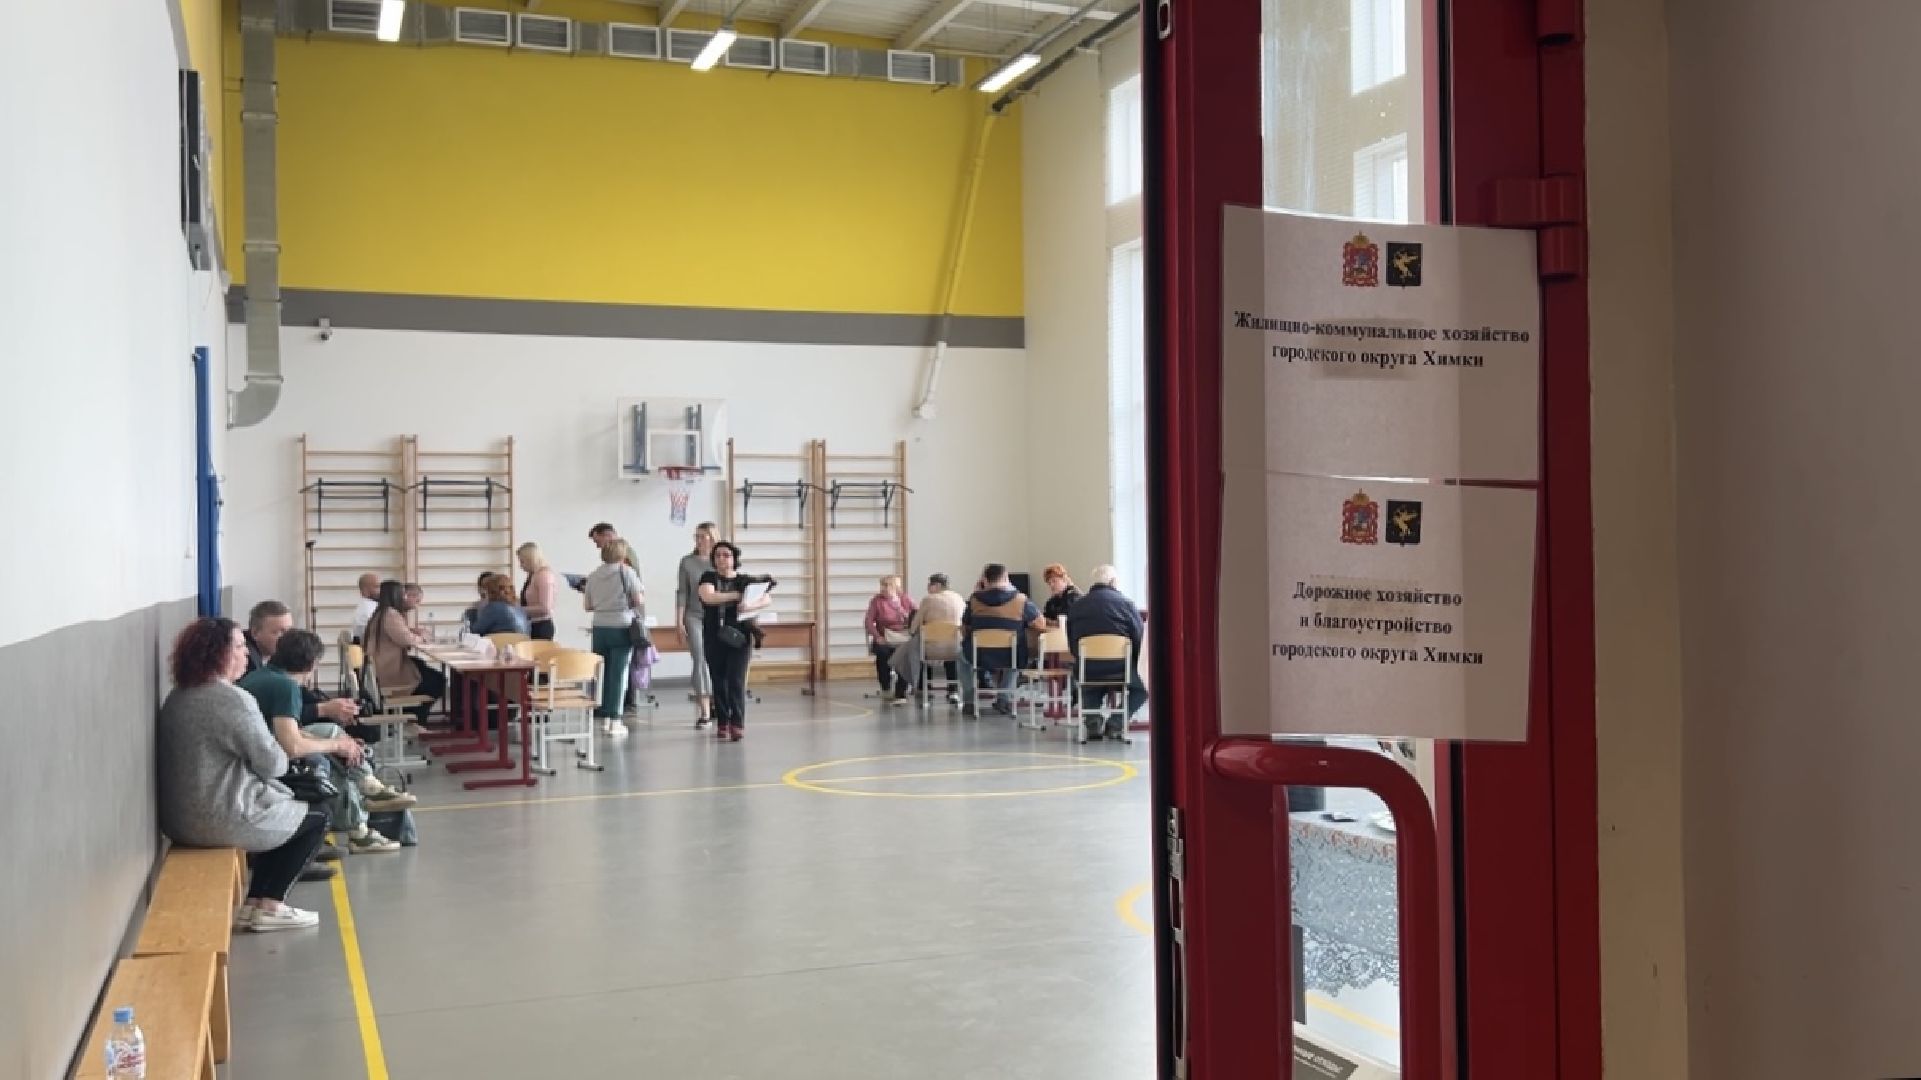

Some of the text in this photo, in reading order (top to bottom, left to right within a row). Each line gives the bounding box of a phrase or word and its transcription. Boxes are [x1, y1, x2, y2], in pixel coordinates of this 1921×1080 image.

[1234, 311, 1530, 343] Жилищно-коммунальное хозяйство
[1271, 344, 1484, 370] городского округа Химки
[1293, 581, 1462, 607] Дорожное хозяйство
[1299, 612, 1453, 635] и благоустройство
[1271, 642, 1484, 664] городского округа Химки
